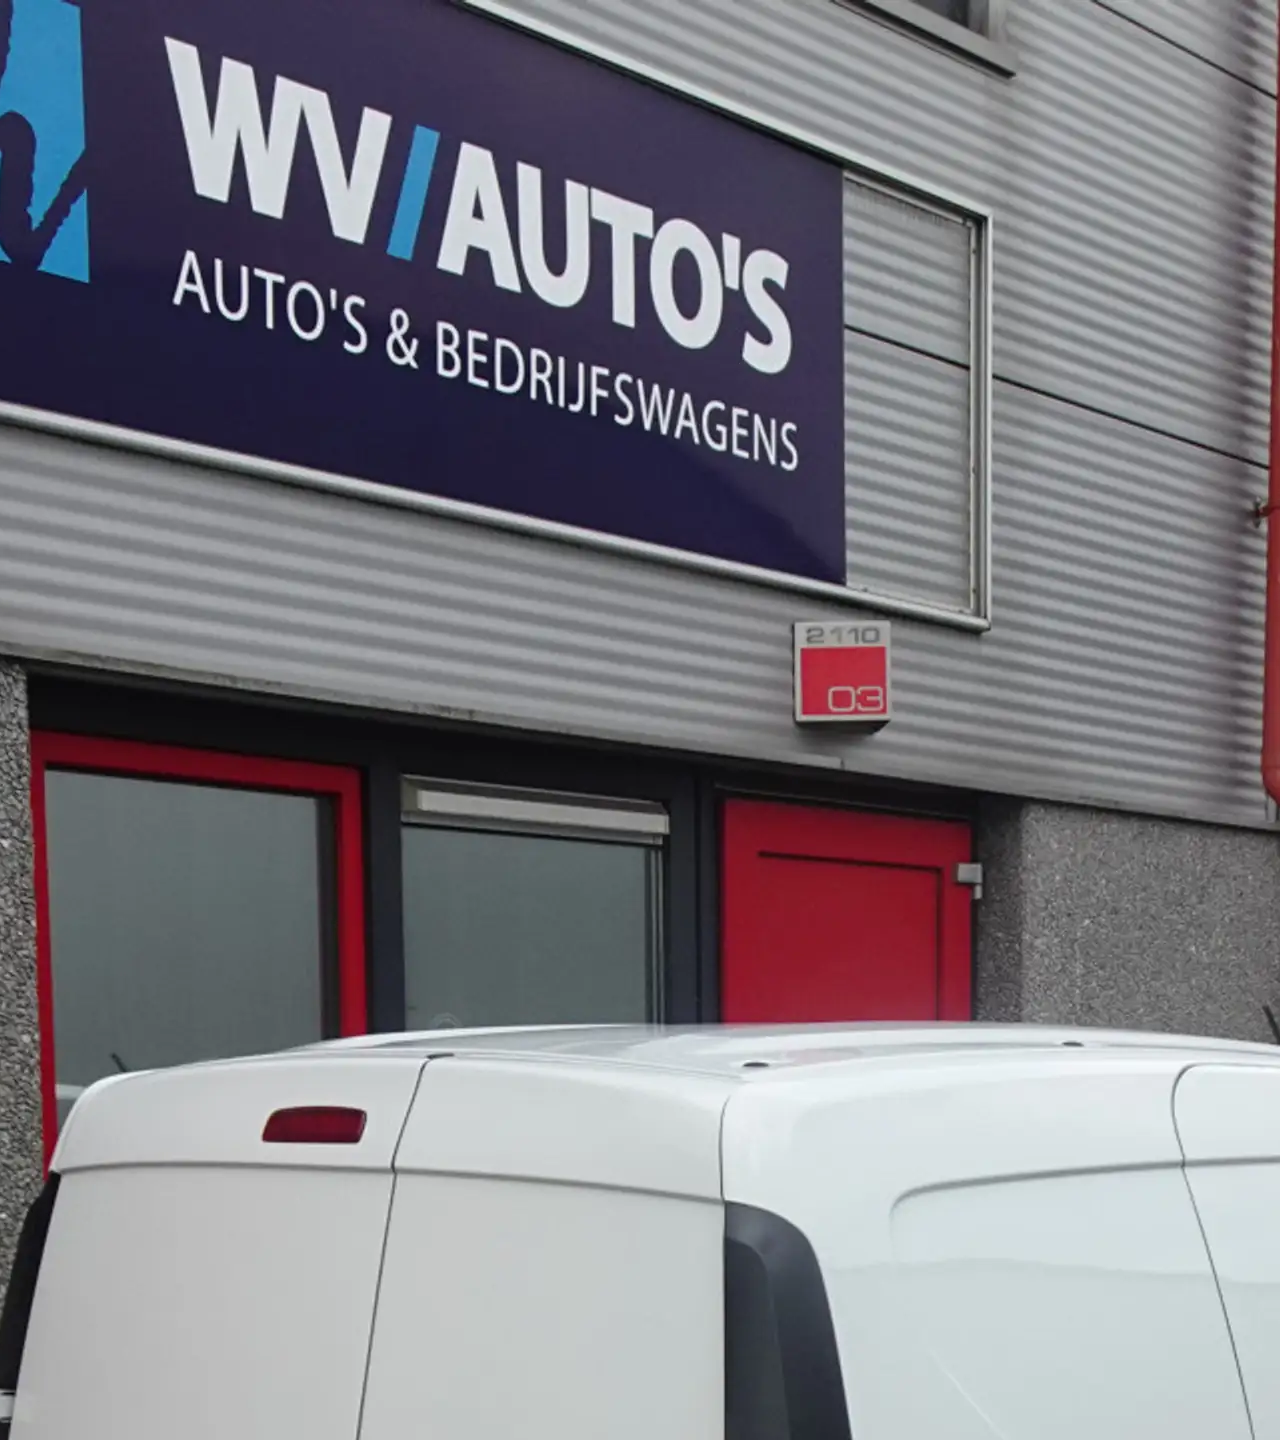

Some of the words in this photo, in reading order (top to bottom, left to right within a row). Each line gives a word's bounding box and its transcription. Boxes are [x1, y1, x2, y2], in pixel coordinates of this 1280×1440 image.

[173, 250, 368, 354] AUTO'S
[386, 308, 418, 369] &
[436, 321, 799, 471] BEDRIJFSWAGENS
[805, 627, 880, 644] 2110
[828, 686, 884, 712] 03
